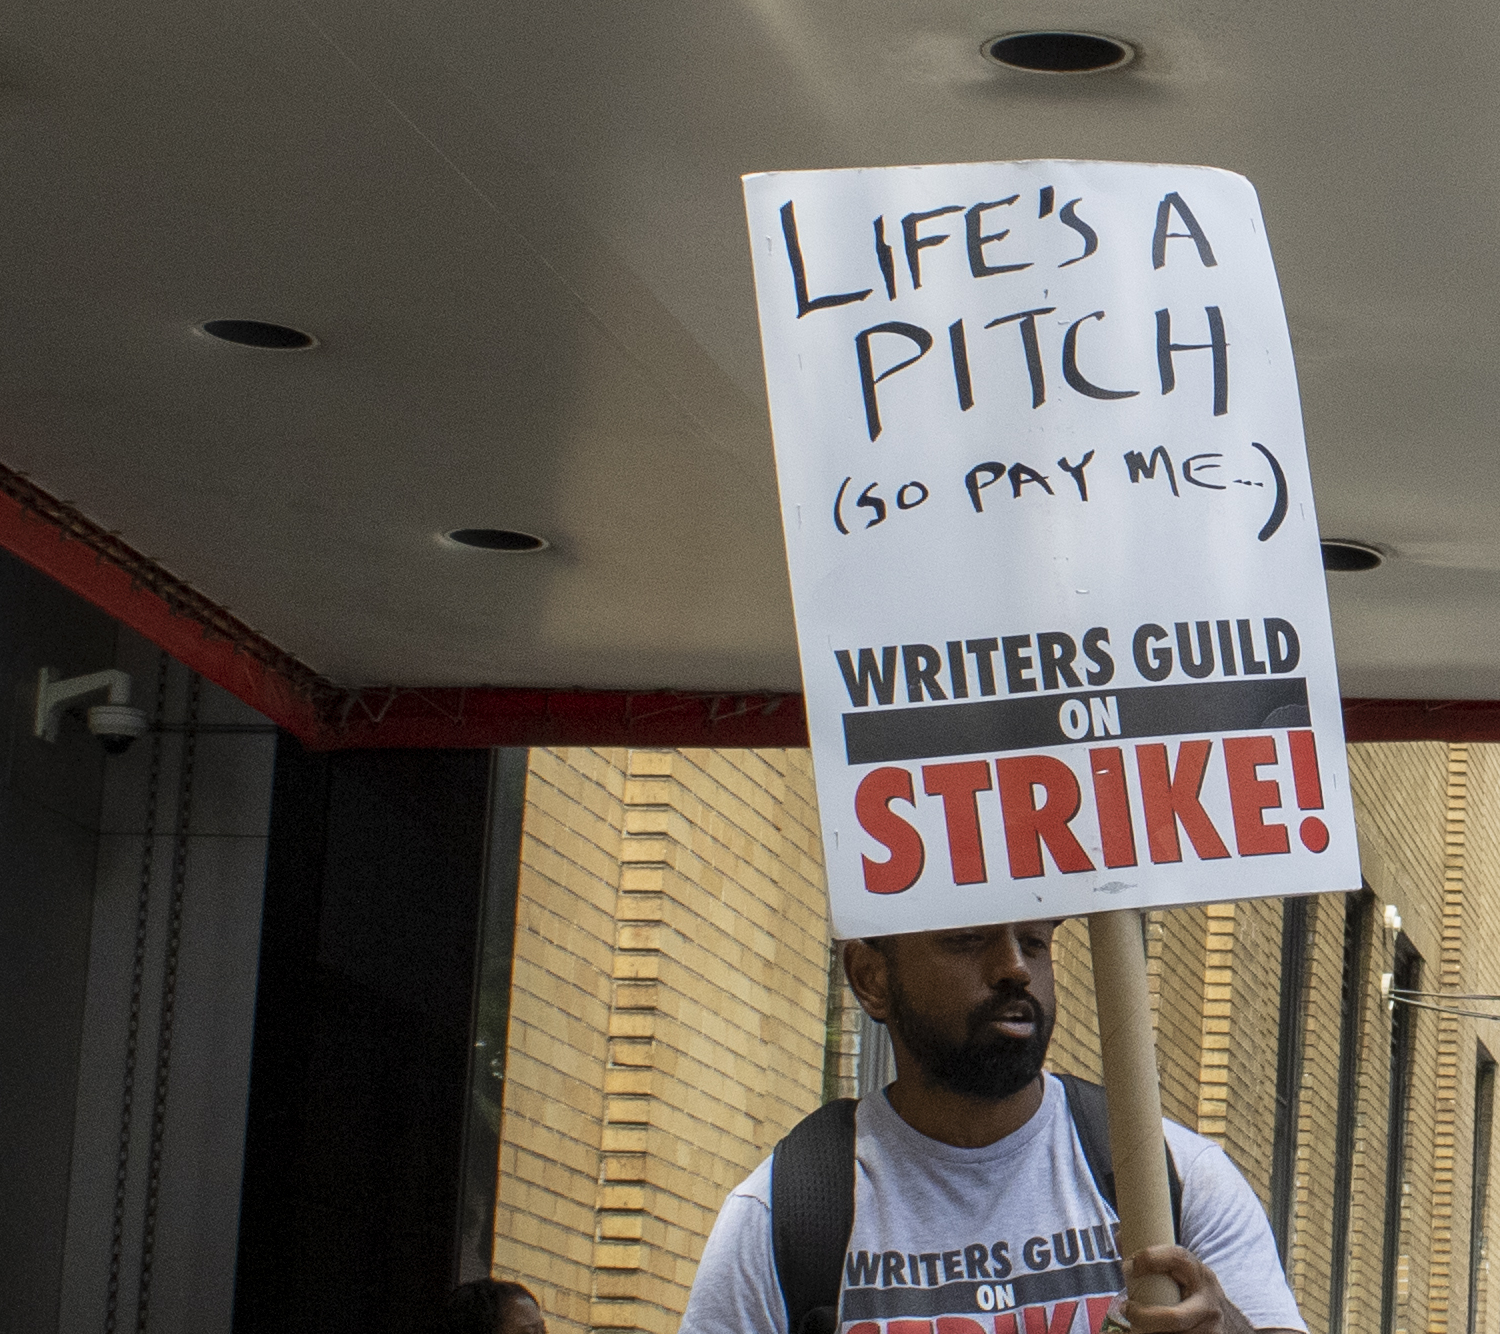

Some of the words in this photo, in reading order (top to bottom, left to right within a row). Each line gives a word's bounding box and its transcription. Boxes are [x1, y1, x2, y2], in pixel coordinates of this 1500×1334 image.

[780, 186, 1099, 319] LIFE'S
[1151, 192, 1218, 270] A
[855, 306, 1231, 443] PITCH
[833, 475, 929, 536] (SO
[965, 449, 1095, 513] PAY
[834, 627, 1116, 707] WRITERS
[1132, 618, 1301, 679] GUILD
[1058, 695, 1121, 739] ON
[854, 729, 1330, 895] STRIKE!
[846, 1240, 1013, 1287] WRITERS
[976, 1283, 1016, 1311] ON
